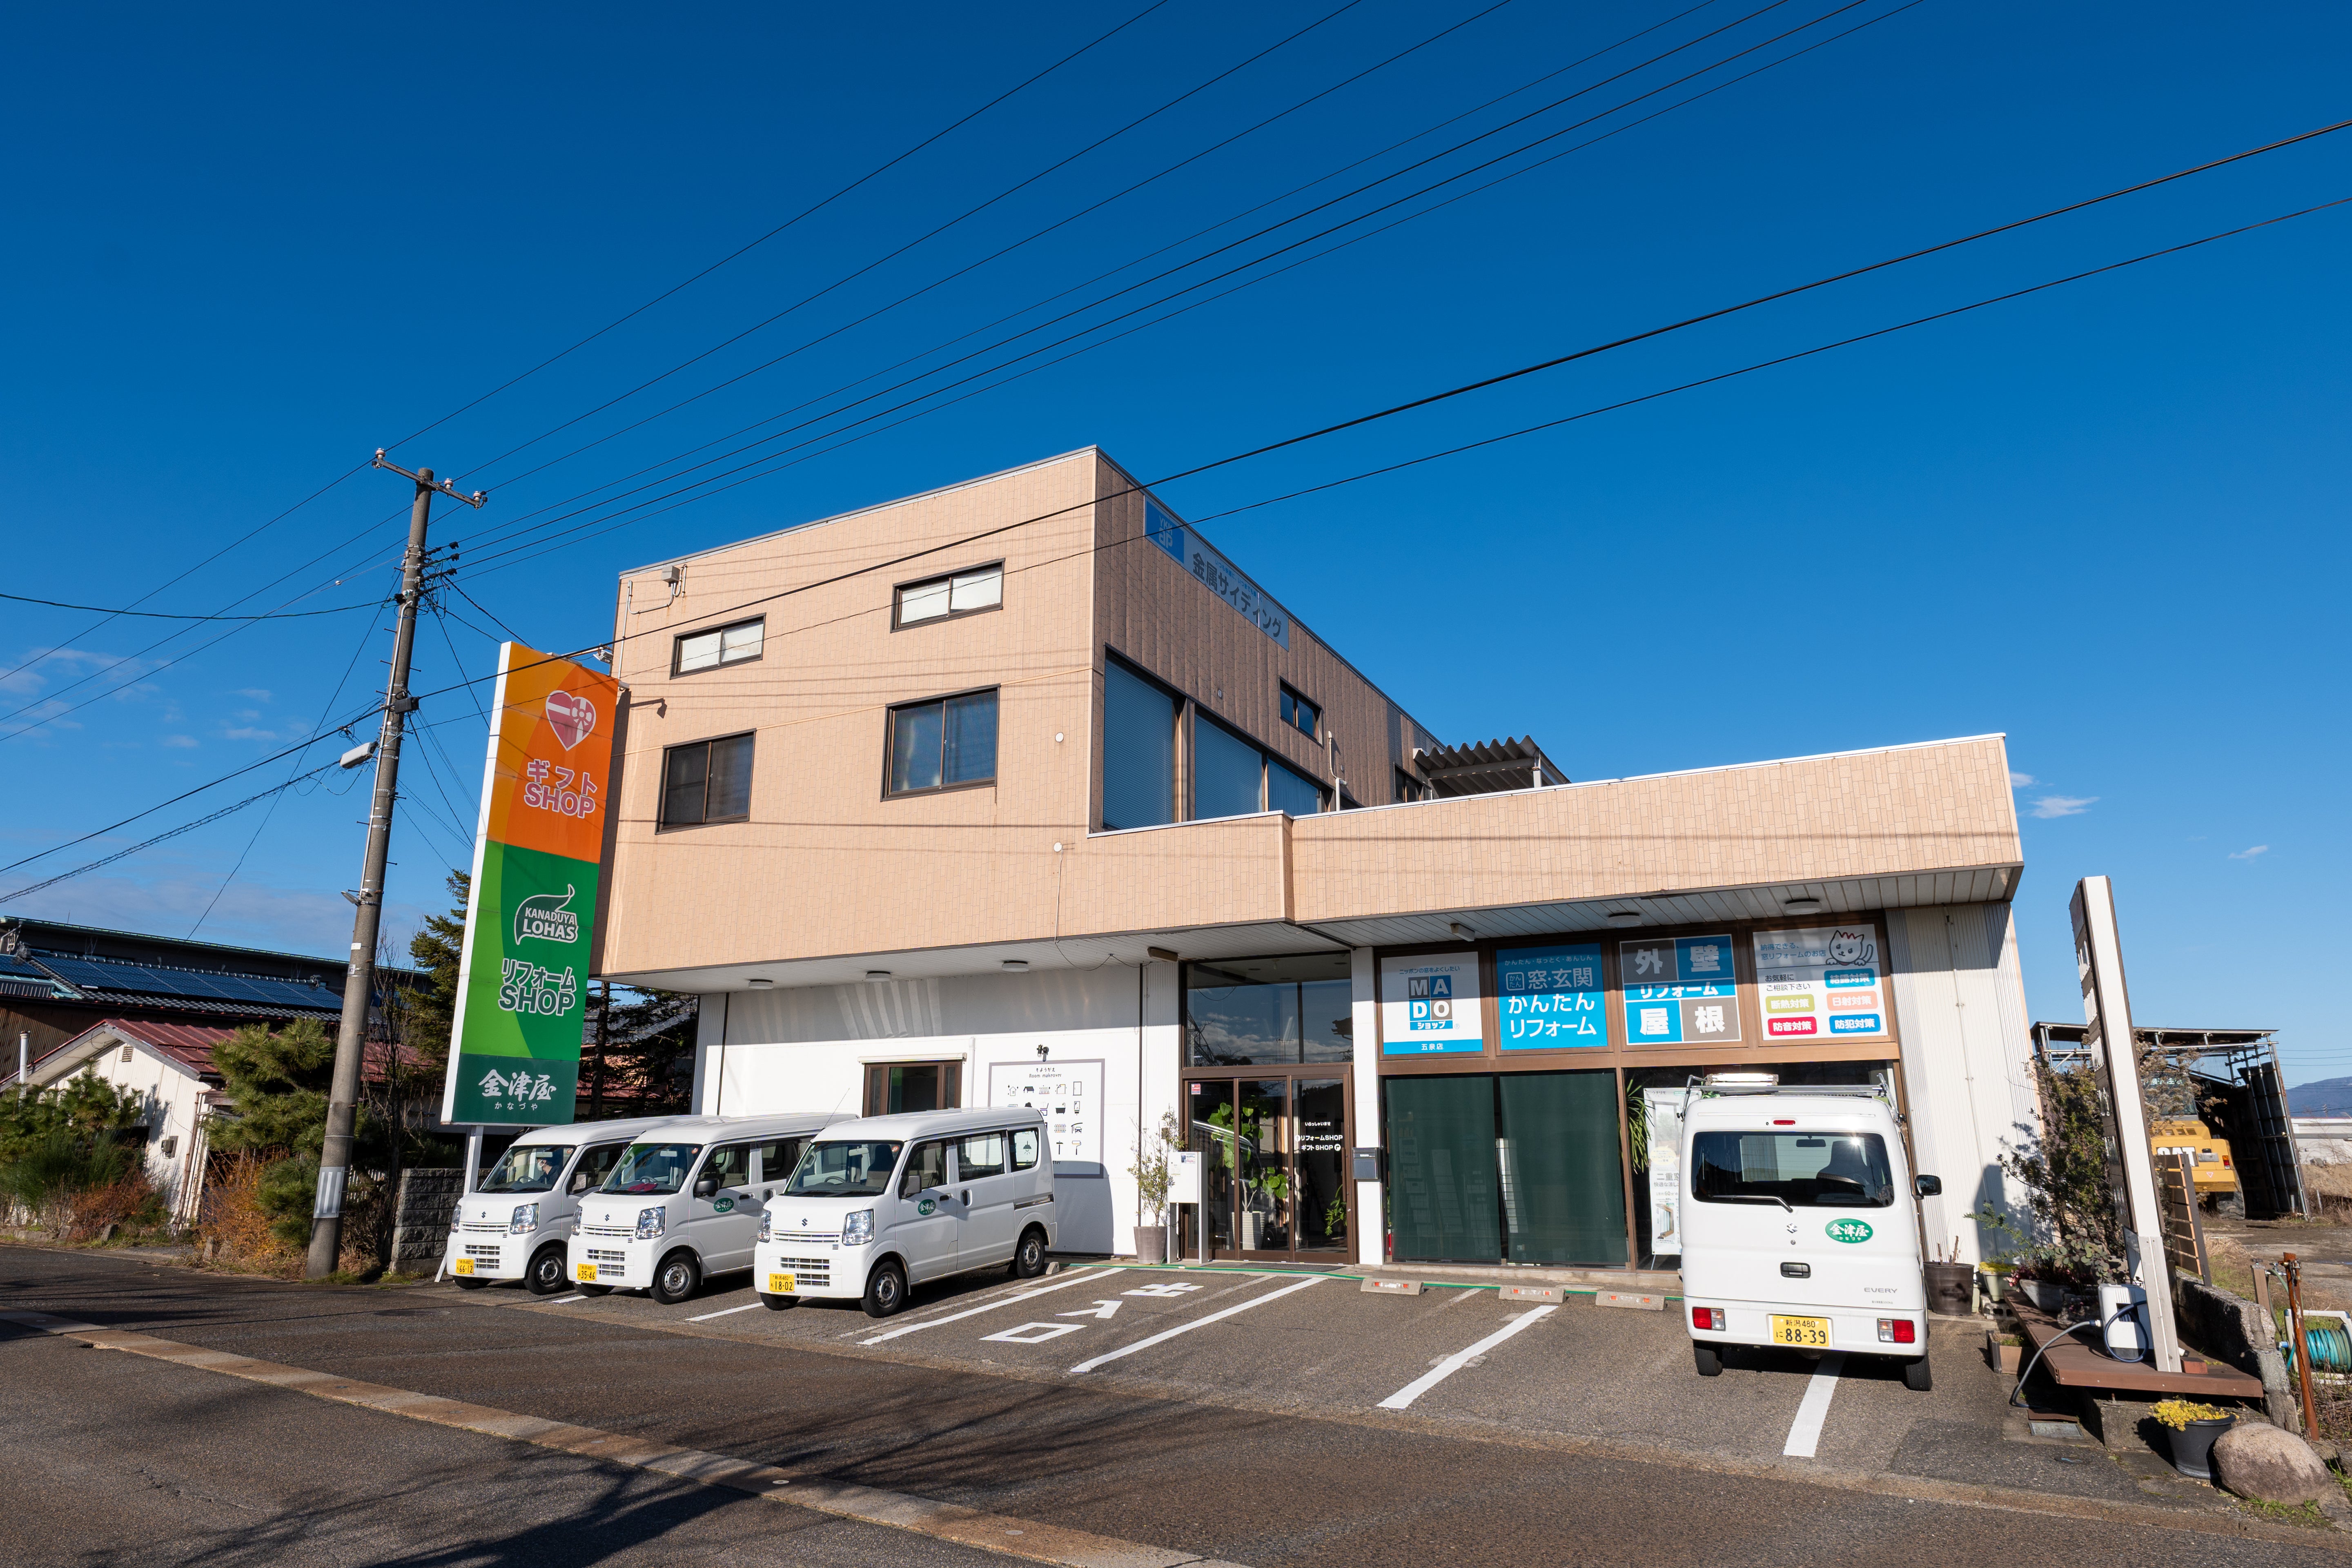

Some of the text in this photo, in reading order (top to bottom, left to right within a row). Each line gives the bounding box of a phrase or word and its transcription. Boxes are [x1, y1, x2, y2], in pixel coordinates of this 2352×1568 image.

[1159, 515, 1173, 536] YKK
[1192, 552, 1282, 638] 金属サイディング
[527, 759, 598, 796] ギフト
[524, 782, 596, 819] SHOP
[525, 907, 575, 925] KANADUYA
[523, 919, 575, 940] LOHAS
[1760, 942, 1799, 951] 納得できる、
[1761, 950, 1826, 960] 窓リフォームのお店
[502, 958, 577, 993] リフォーム
[1399, 966, 1460, 974] ニッポンの窓をよくしたい
[1528, 967, 1593, 989] 窓・玄関
[1765, 974, 1794, 982] お気軽に
[1830, 973, 1870, 984] 結露対策
[1640, 981, 1718, 999] リフォーム
[1766, 983, 1811, 991] ご相談下さい
[498, 985, 576, 1017] SHOP
[1508, 992, 1595, 1014] かんたん
[1770, 998, 1810, 1010] 断熱対策
[1832, 996, 1872, 1007] 日射対策
[1417, 1021, 1446, 1030] ショップ
[1510, 1016, 1597, 1038] リフォーム
[1639, 1005, 1725, 1036] 屋根
[1773, 1021, 1812, 1032] 防音対策
[1834, 1018, 1875, 1029] 防犯対策
[478, 1069, 557, 1102] 金津屋
[494, 1101, 538, 1111] かなづや
[1829, 1223, 1869, 1237] 金津屋
[775, 1281, 793, 1291] 18-02
[1786, 1328, 1826, 1344] 88-39
